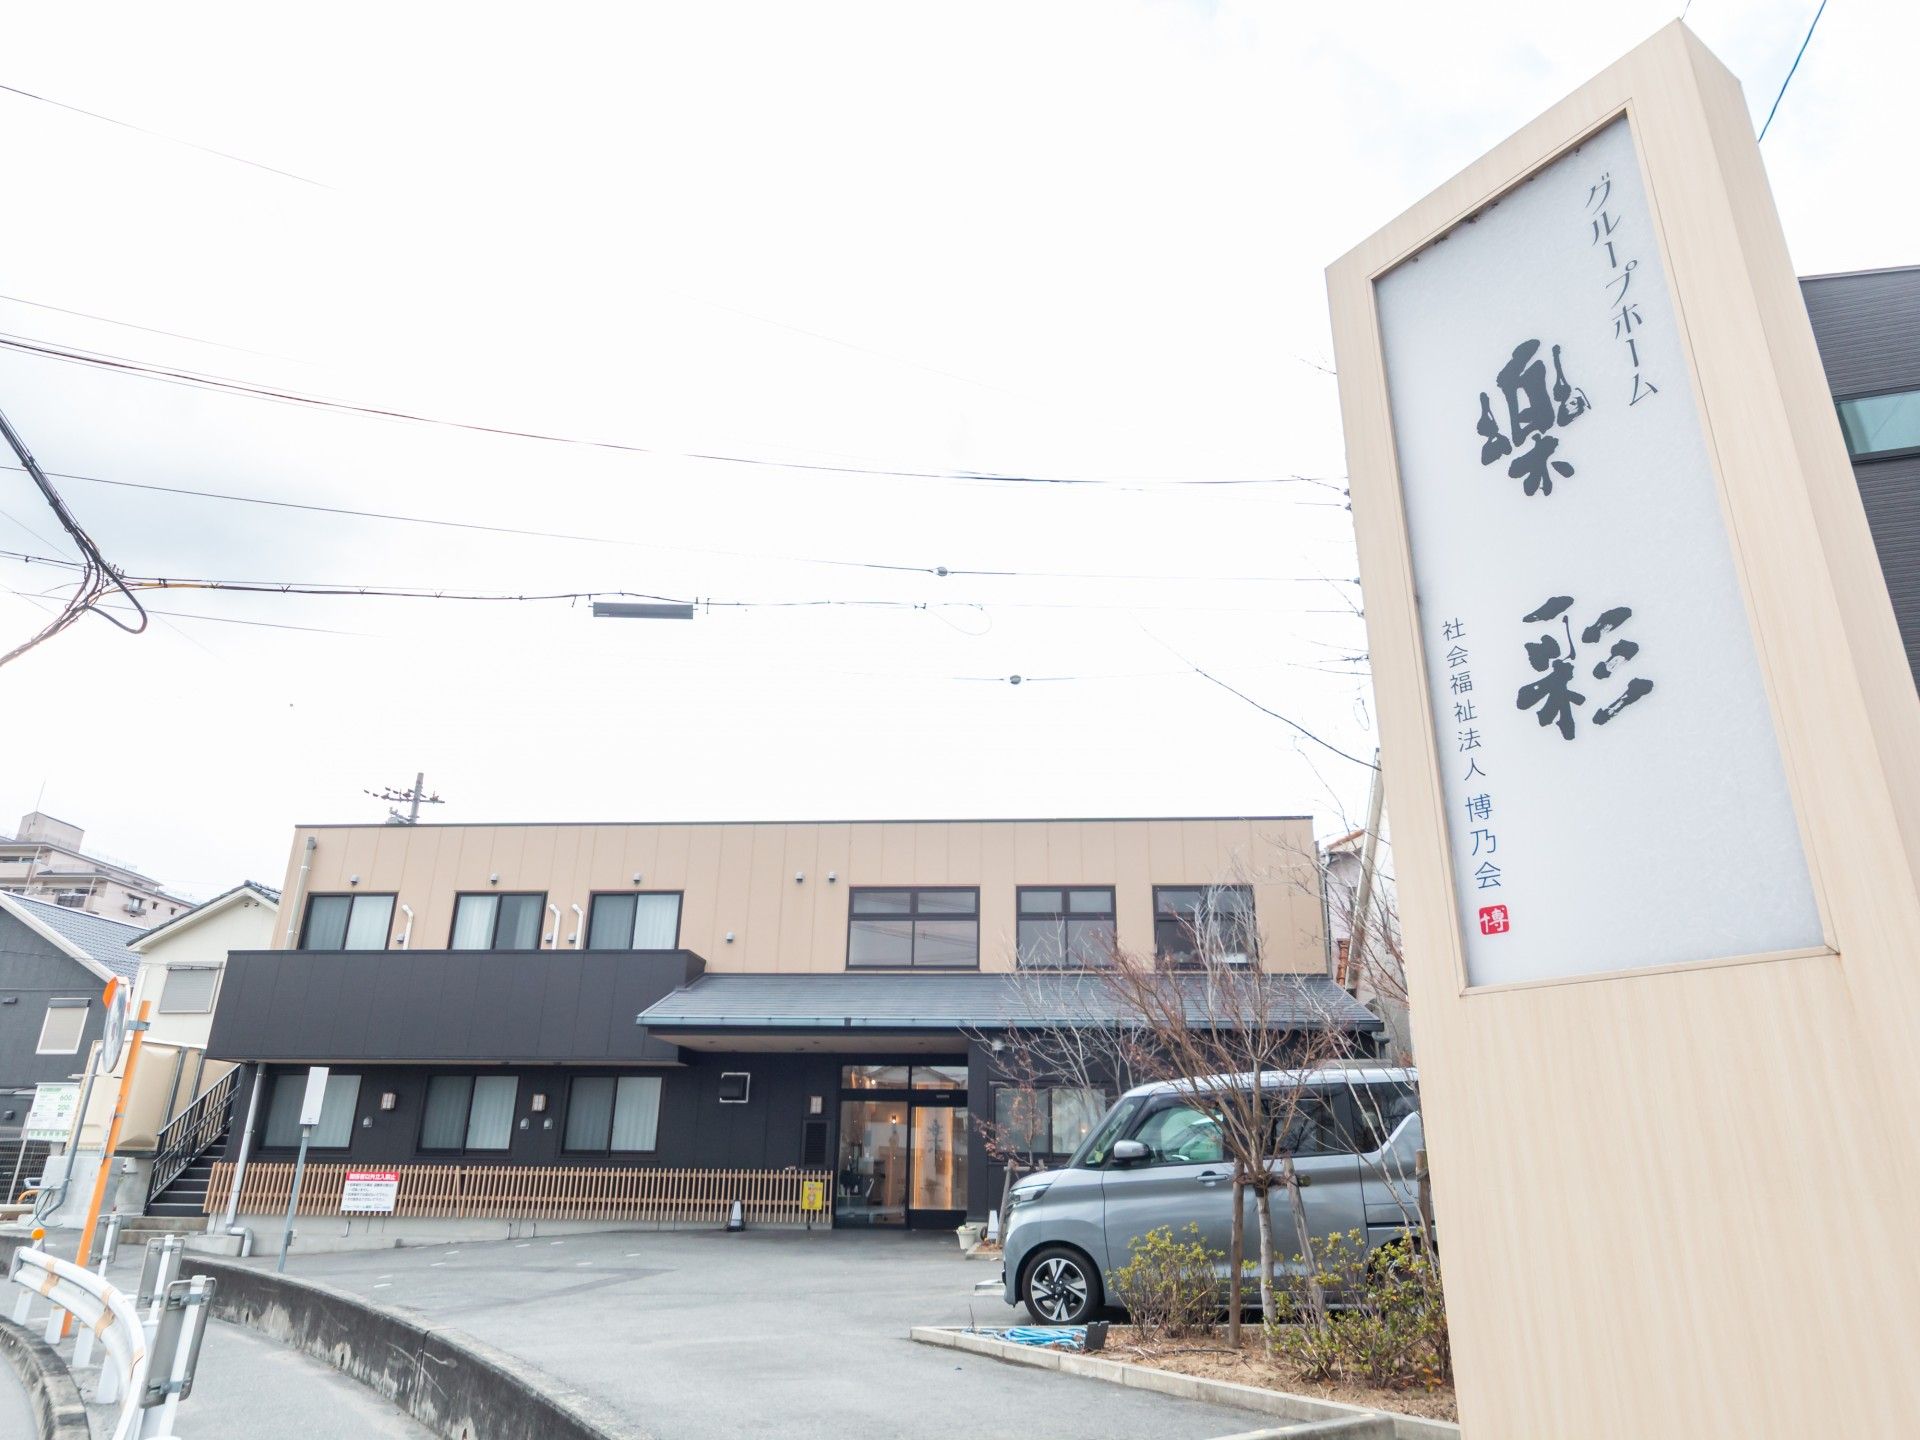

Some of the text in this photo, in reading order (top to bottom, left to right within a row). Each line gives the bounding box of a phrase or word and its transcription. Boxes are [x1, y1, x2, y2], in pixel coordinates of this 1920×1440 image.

[1584, 171, 1659, 407] グループホーム
[1441, 616, 1502, 890] 社会福祉法人 博乃会
